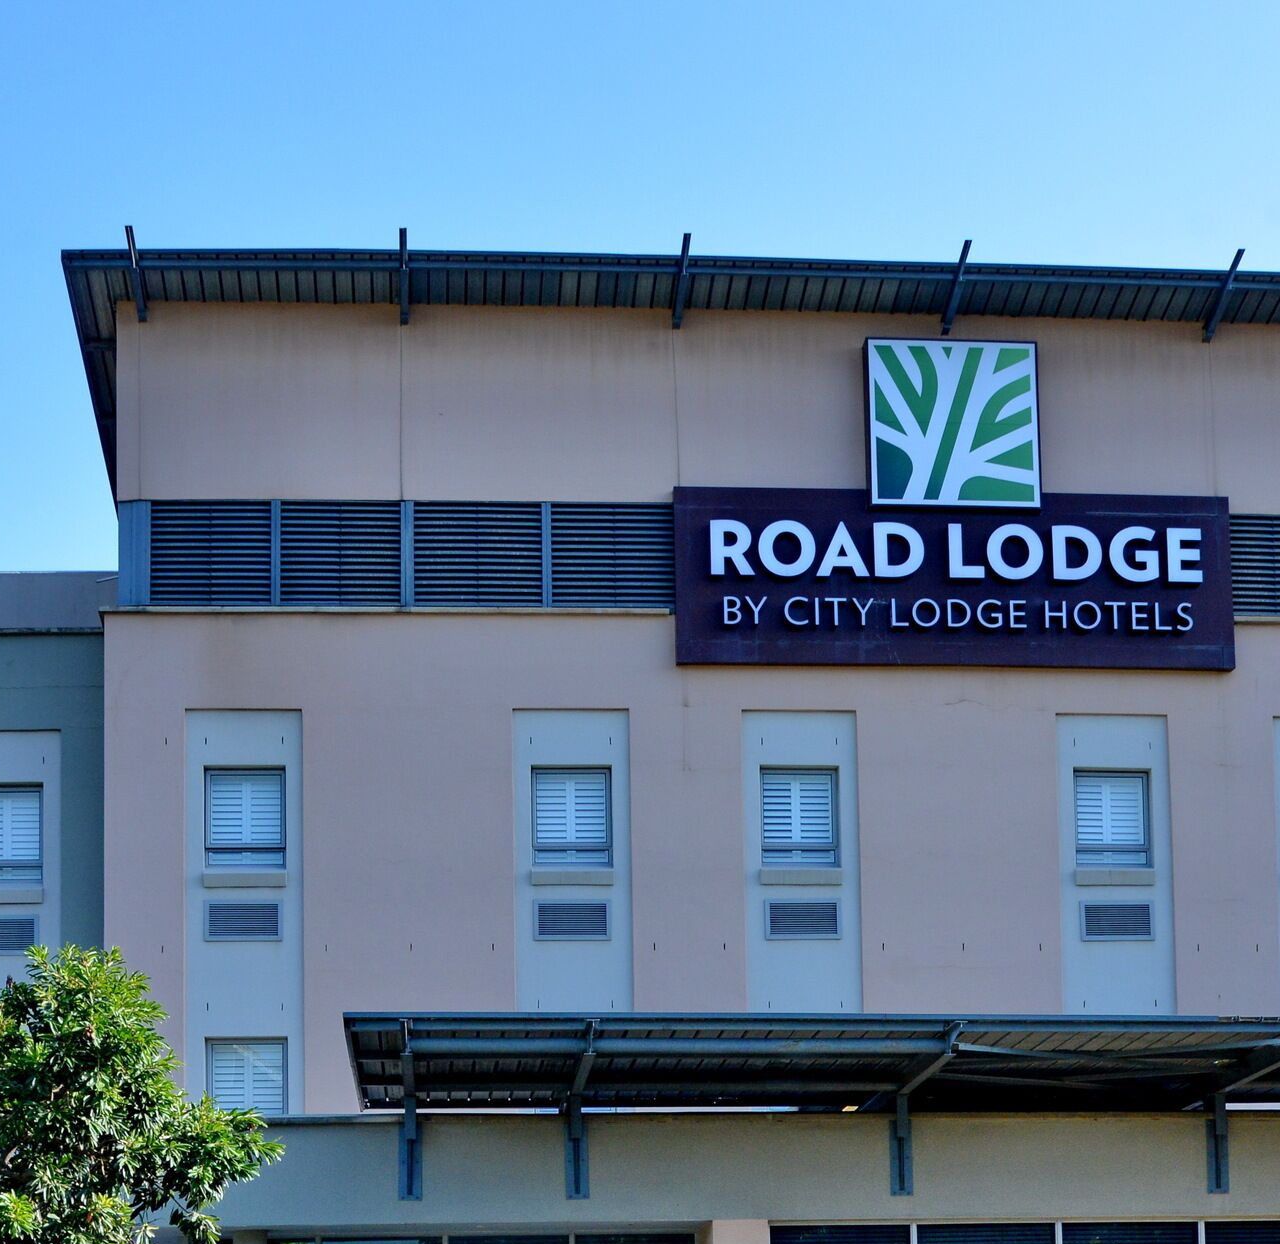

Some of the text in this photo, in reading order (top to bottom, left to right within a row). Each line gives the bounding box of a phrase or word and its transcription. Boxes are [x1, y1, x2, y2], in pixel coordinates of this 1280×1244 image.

[710, 519, 1203, 582] ROAD LODGE
[723, 596, 1194, 631] BY CITY LODGE HOTELS
